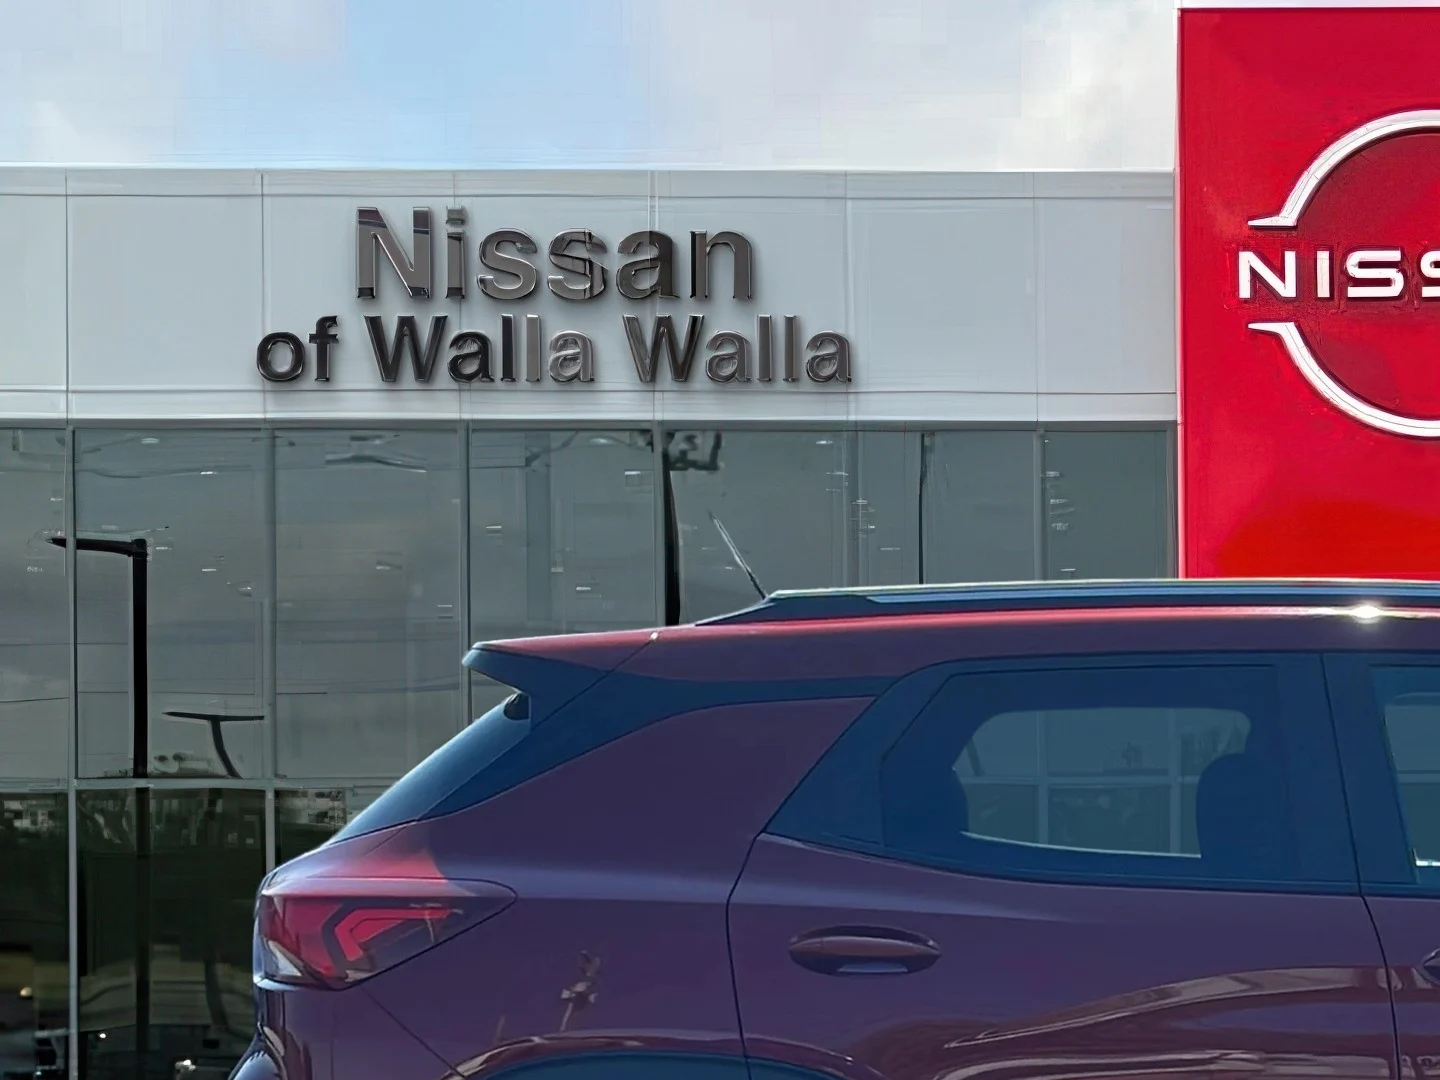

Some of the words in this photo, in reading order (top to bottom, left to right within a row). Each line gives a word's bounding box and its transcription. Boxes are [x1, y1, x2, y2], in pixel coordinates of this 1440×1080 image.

[356, 206, 754, 300] Nissan
[256, 315, 340, 383] of
[362, 314, 596, 383] Walla
[622, 314, 853, 383] Walla
